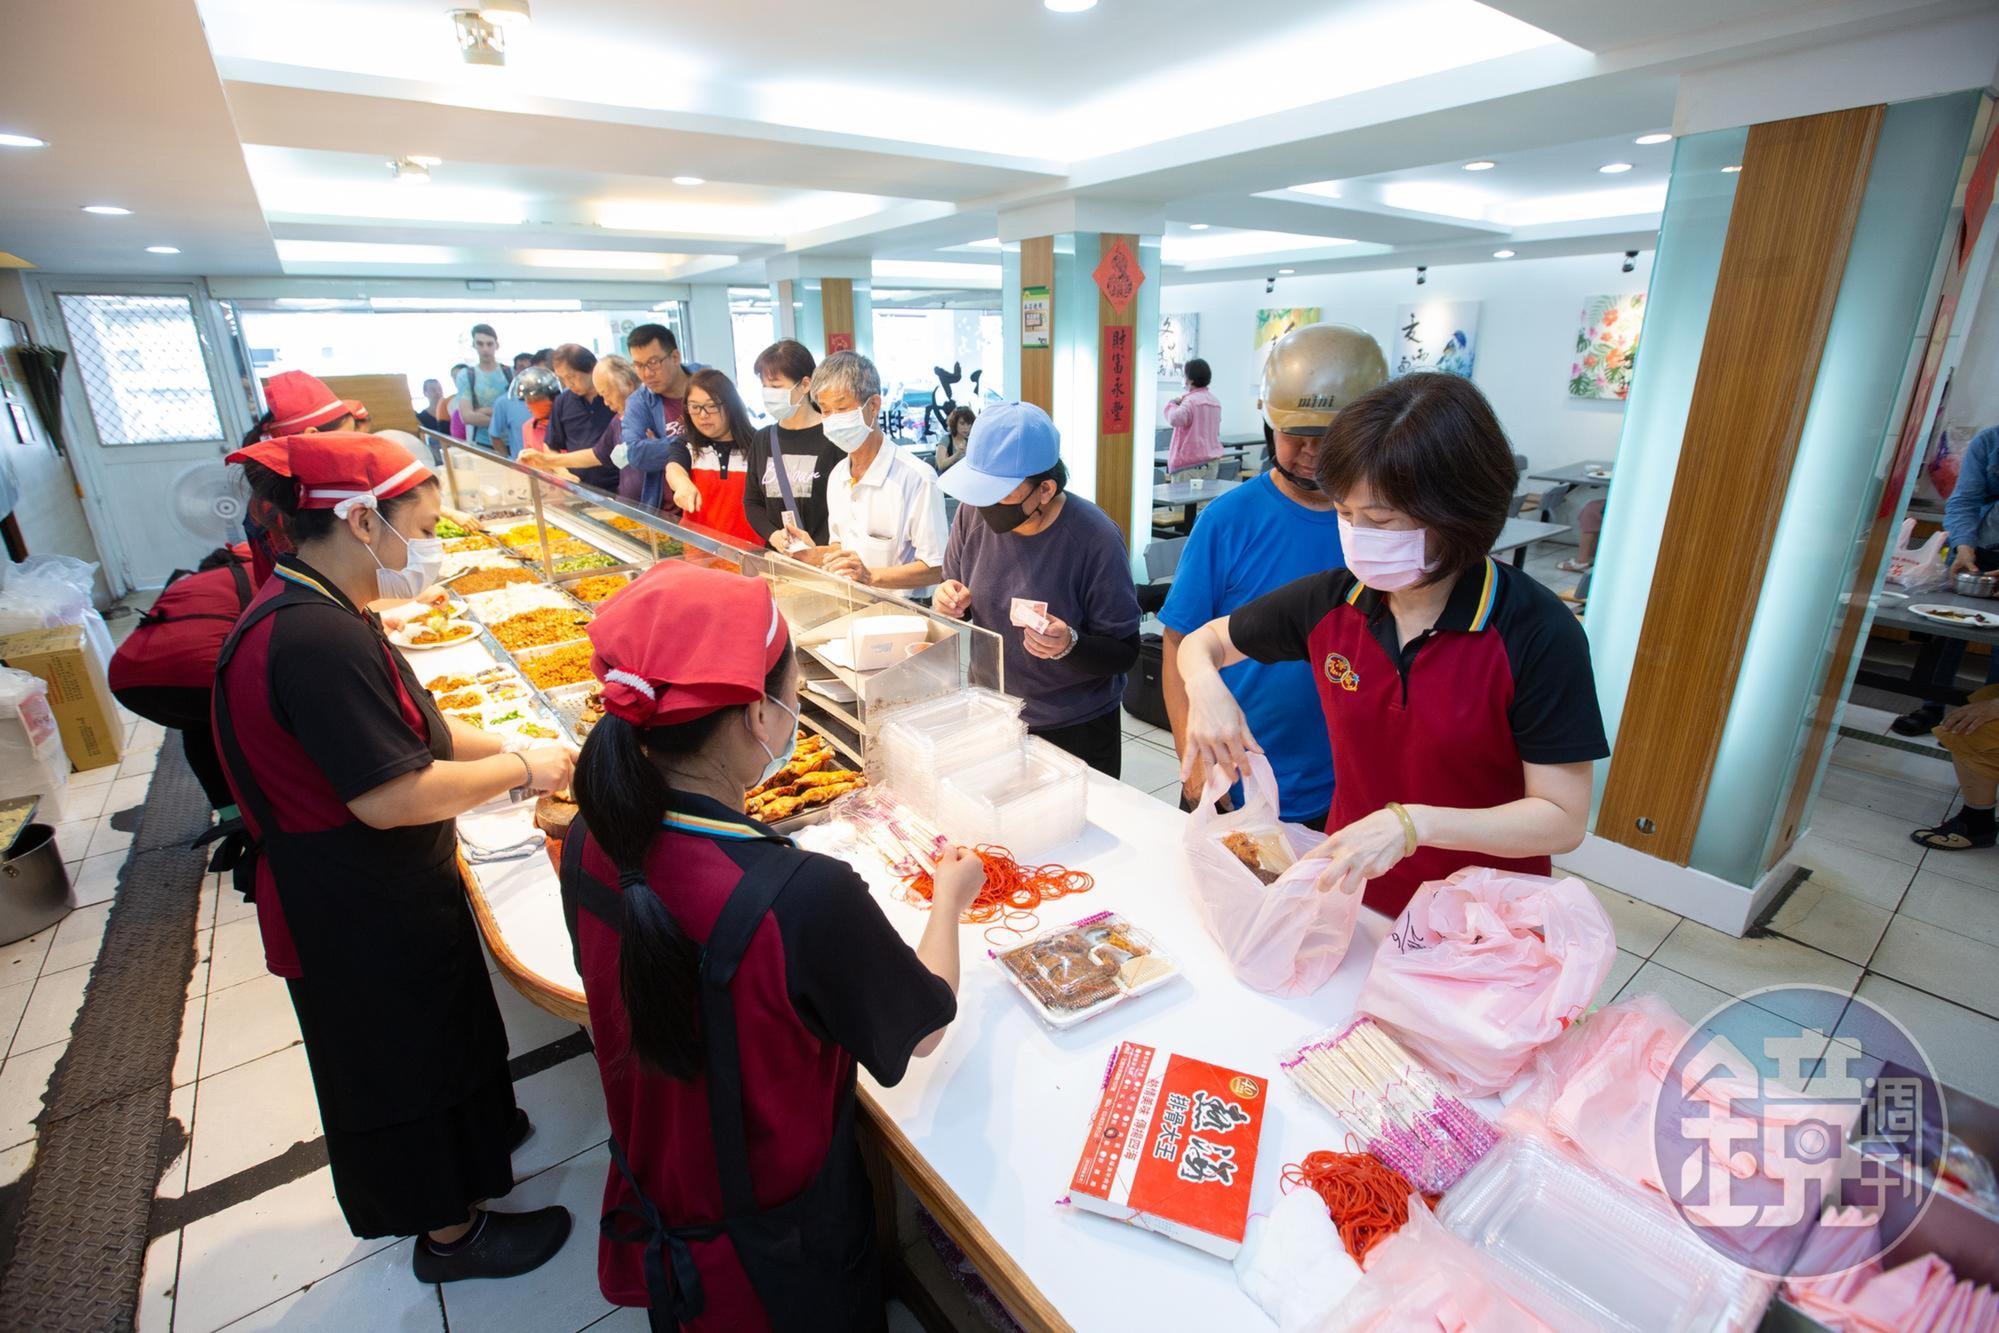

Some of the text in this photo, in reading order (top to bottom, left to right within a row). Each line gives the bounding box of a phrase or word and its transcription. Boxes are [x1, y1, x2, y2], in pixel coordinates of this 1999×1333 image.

[1297, 395, 1335, 408] mini
[1154, 1094, 1190, 1162] 排骨大王
